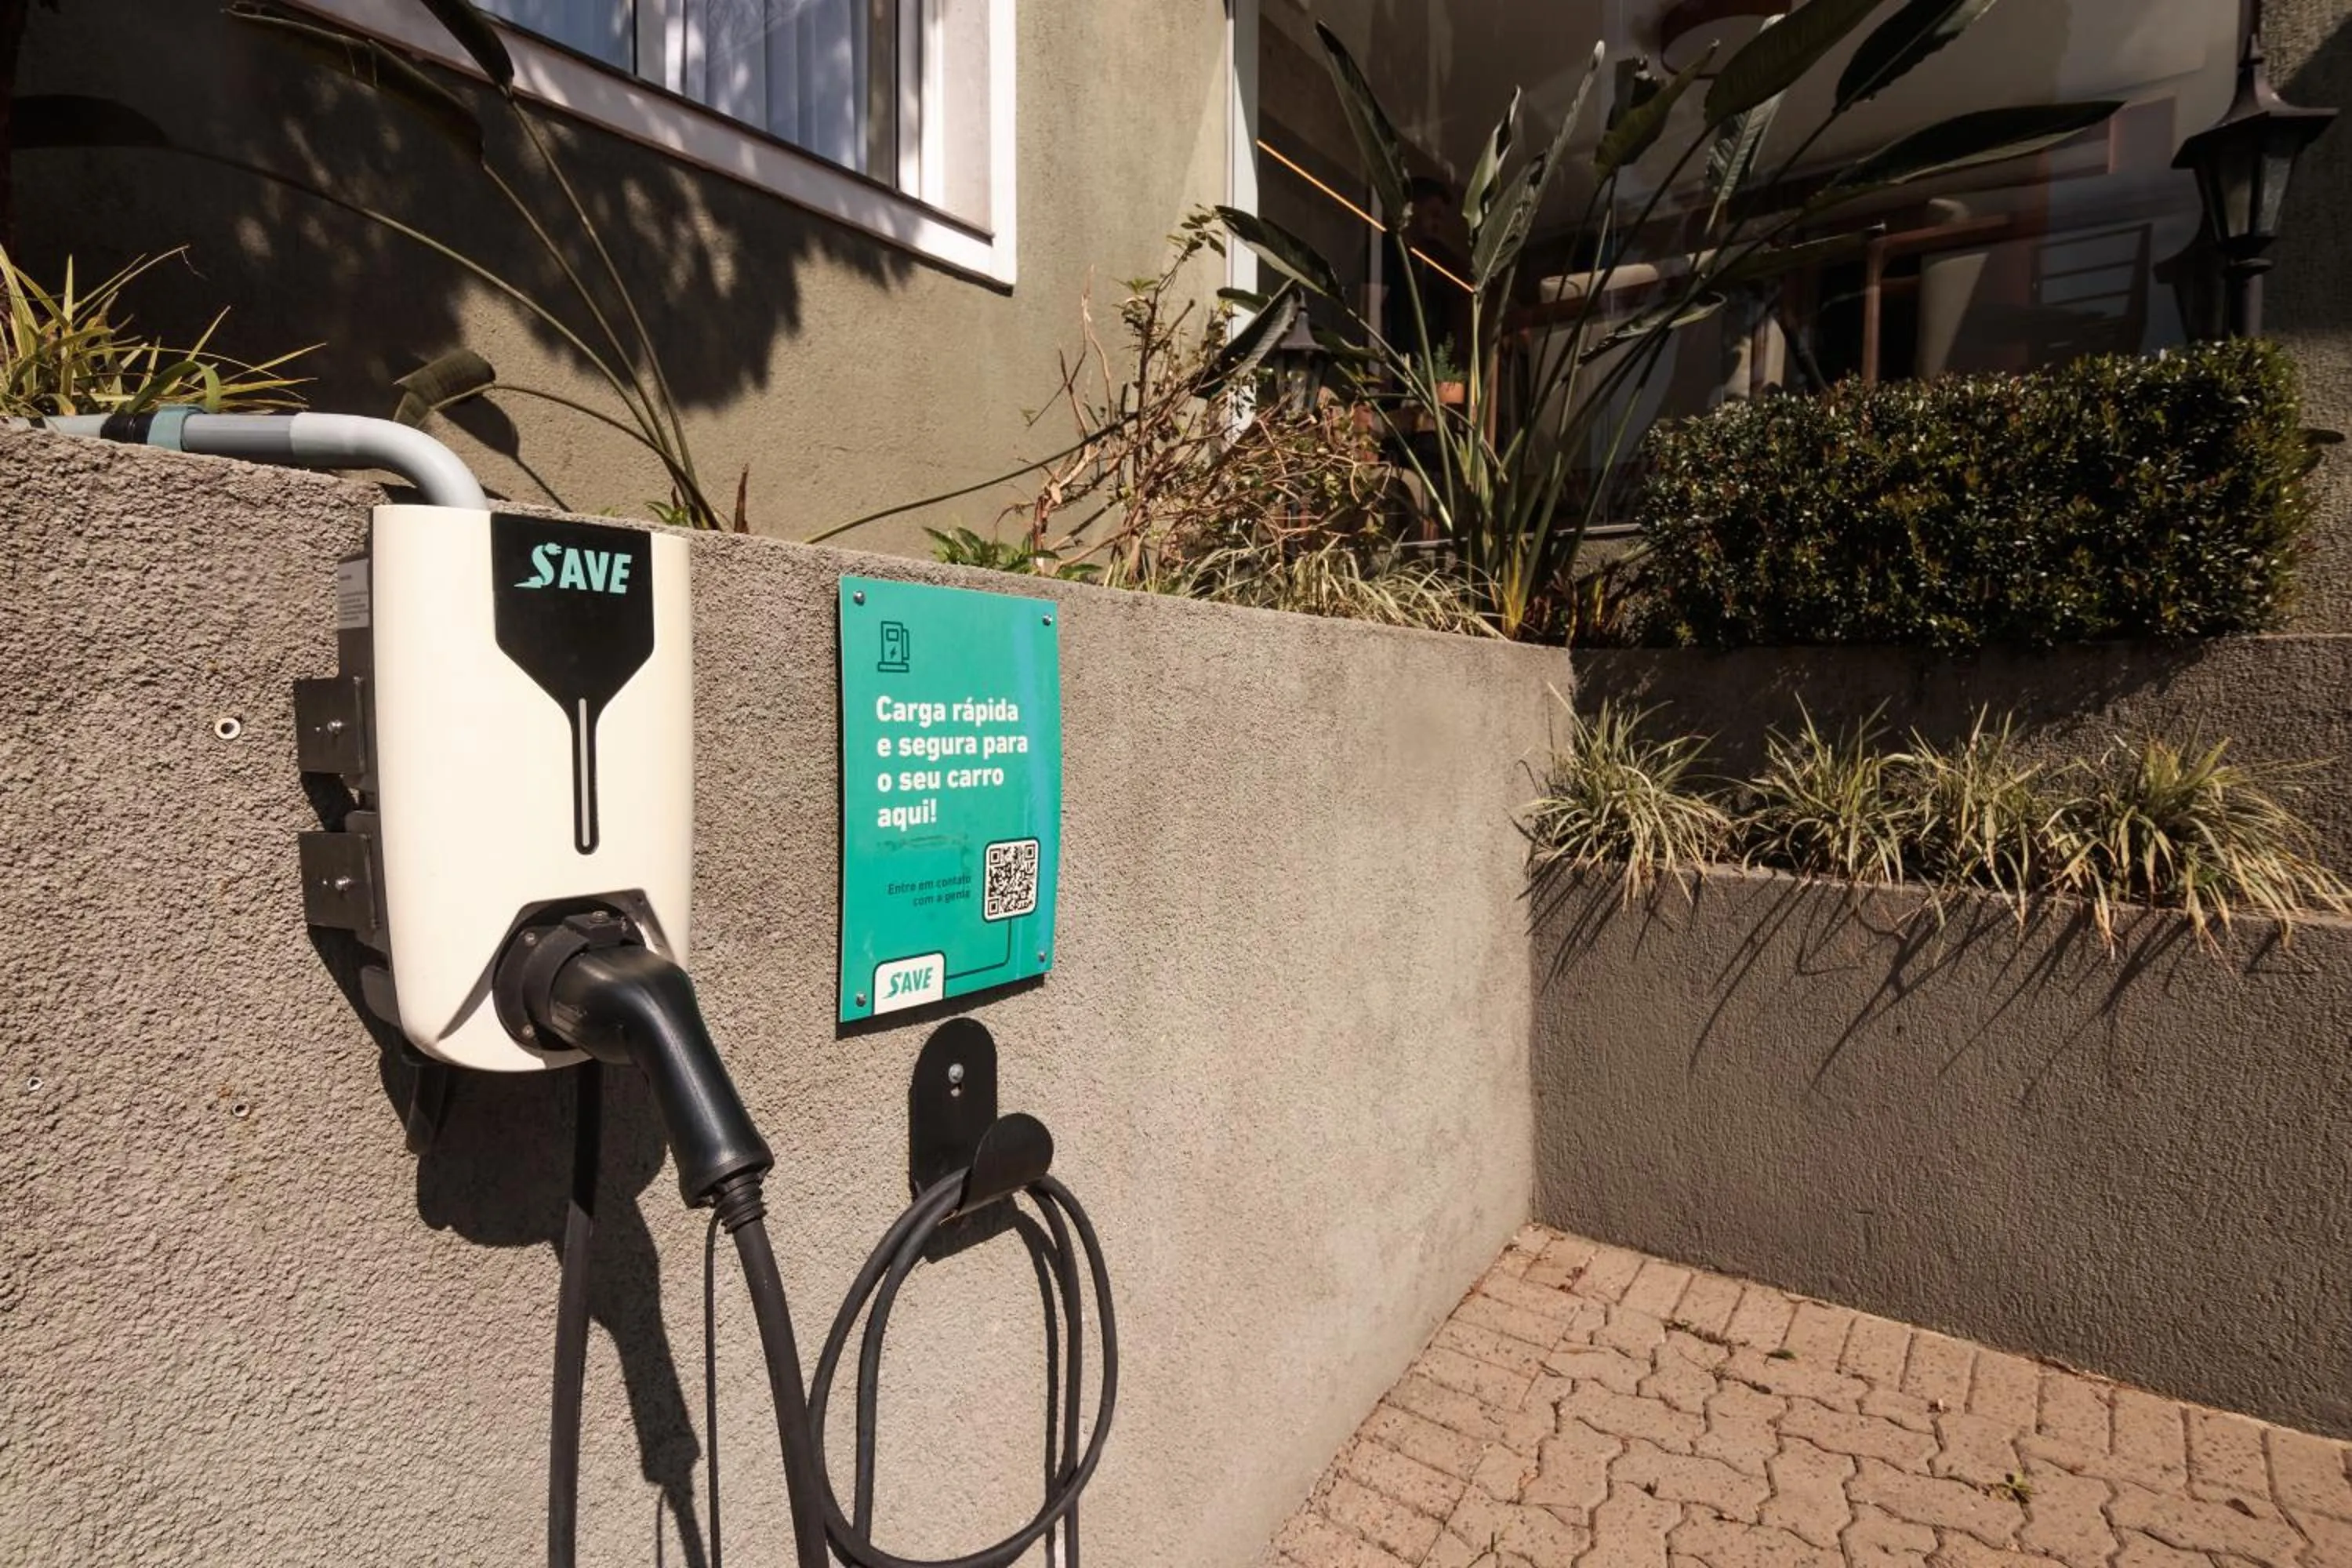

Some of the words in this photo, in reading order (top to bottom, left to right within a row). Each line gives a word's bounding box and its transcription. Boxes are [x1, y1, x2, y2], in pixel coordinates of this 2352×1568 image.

[514, 543, 632, 593] SAVE
[876, 695, 946, 728] Carga
[953, 696, 1018, 728] rápida
[877, 737, 891, 757] e
[898, 735, 977, 760] segura
[983, 735, 1028, 760] para
[877, 772, 891, 792] o
[899, 771, 941, 792] seu
[947, 767, 1004, 788] carro
[877, 798, 937, 832] aqui!
[887, 882, 916, 895] Entre
[918, 880, 933, 891] em
[913, 895, 933, 907] com
[882, 967, 933, 1000] SAVE
